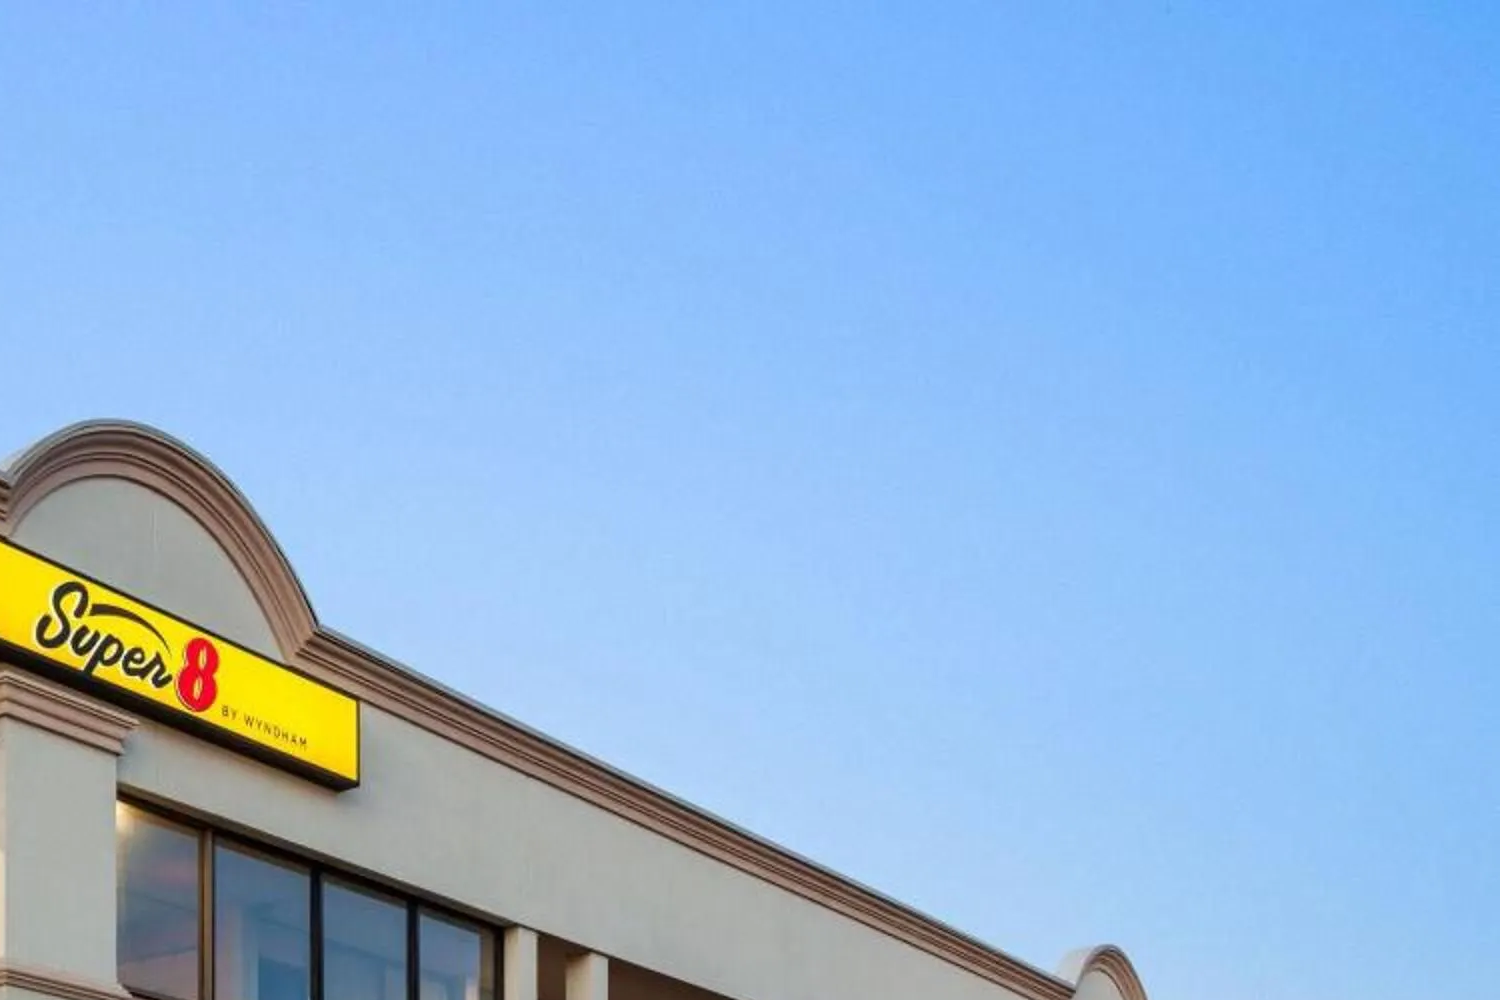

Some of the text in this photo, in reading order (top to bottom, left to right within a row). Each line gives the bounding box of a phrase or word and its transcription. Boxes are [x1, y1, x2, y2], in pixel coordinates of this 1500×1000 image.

[35, 580, 220, 712] Super 8
[221, 704, 308, 750] BY WYNDHAM
